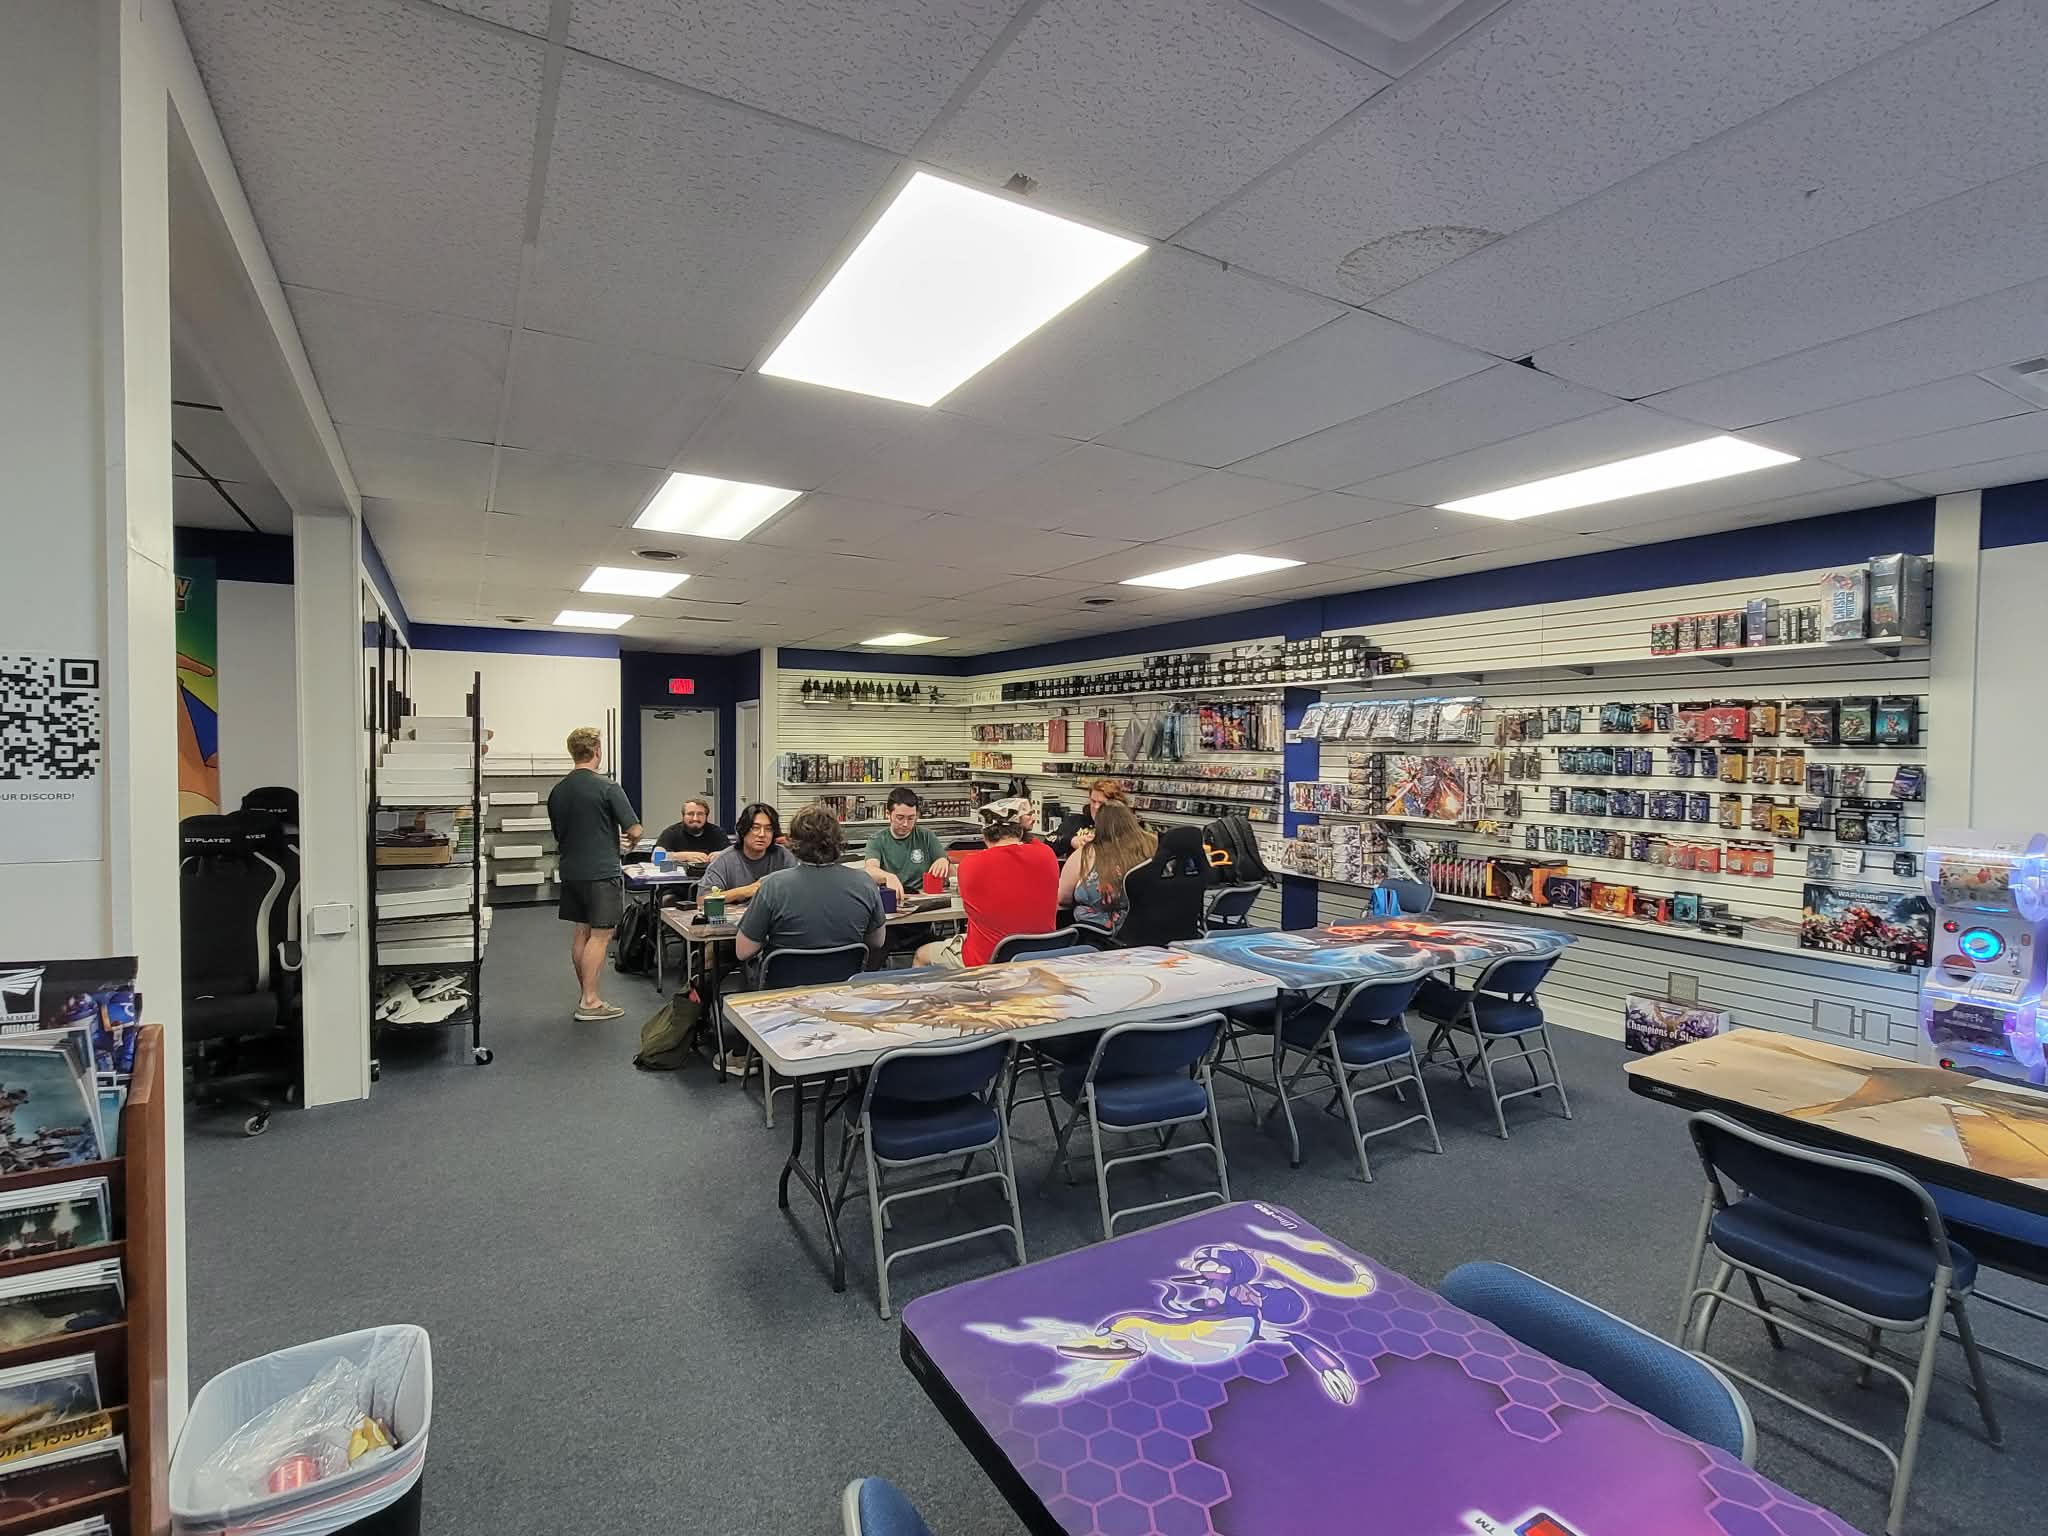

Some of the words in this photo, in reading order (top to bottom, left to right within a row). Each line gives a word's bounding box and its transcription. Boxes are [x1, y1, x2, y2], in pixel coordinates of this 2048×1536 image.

[0, 793, 17, 801] UR
[20, 793, 75, 801] DISCORD!
[1626, 1019, 1668, 1037] Champions
[1669, 1030, 1678, 1040] of
[1679, 1030, 1700, 1043] Slaa
[1475, 1517, 1496, 1535] TM
